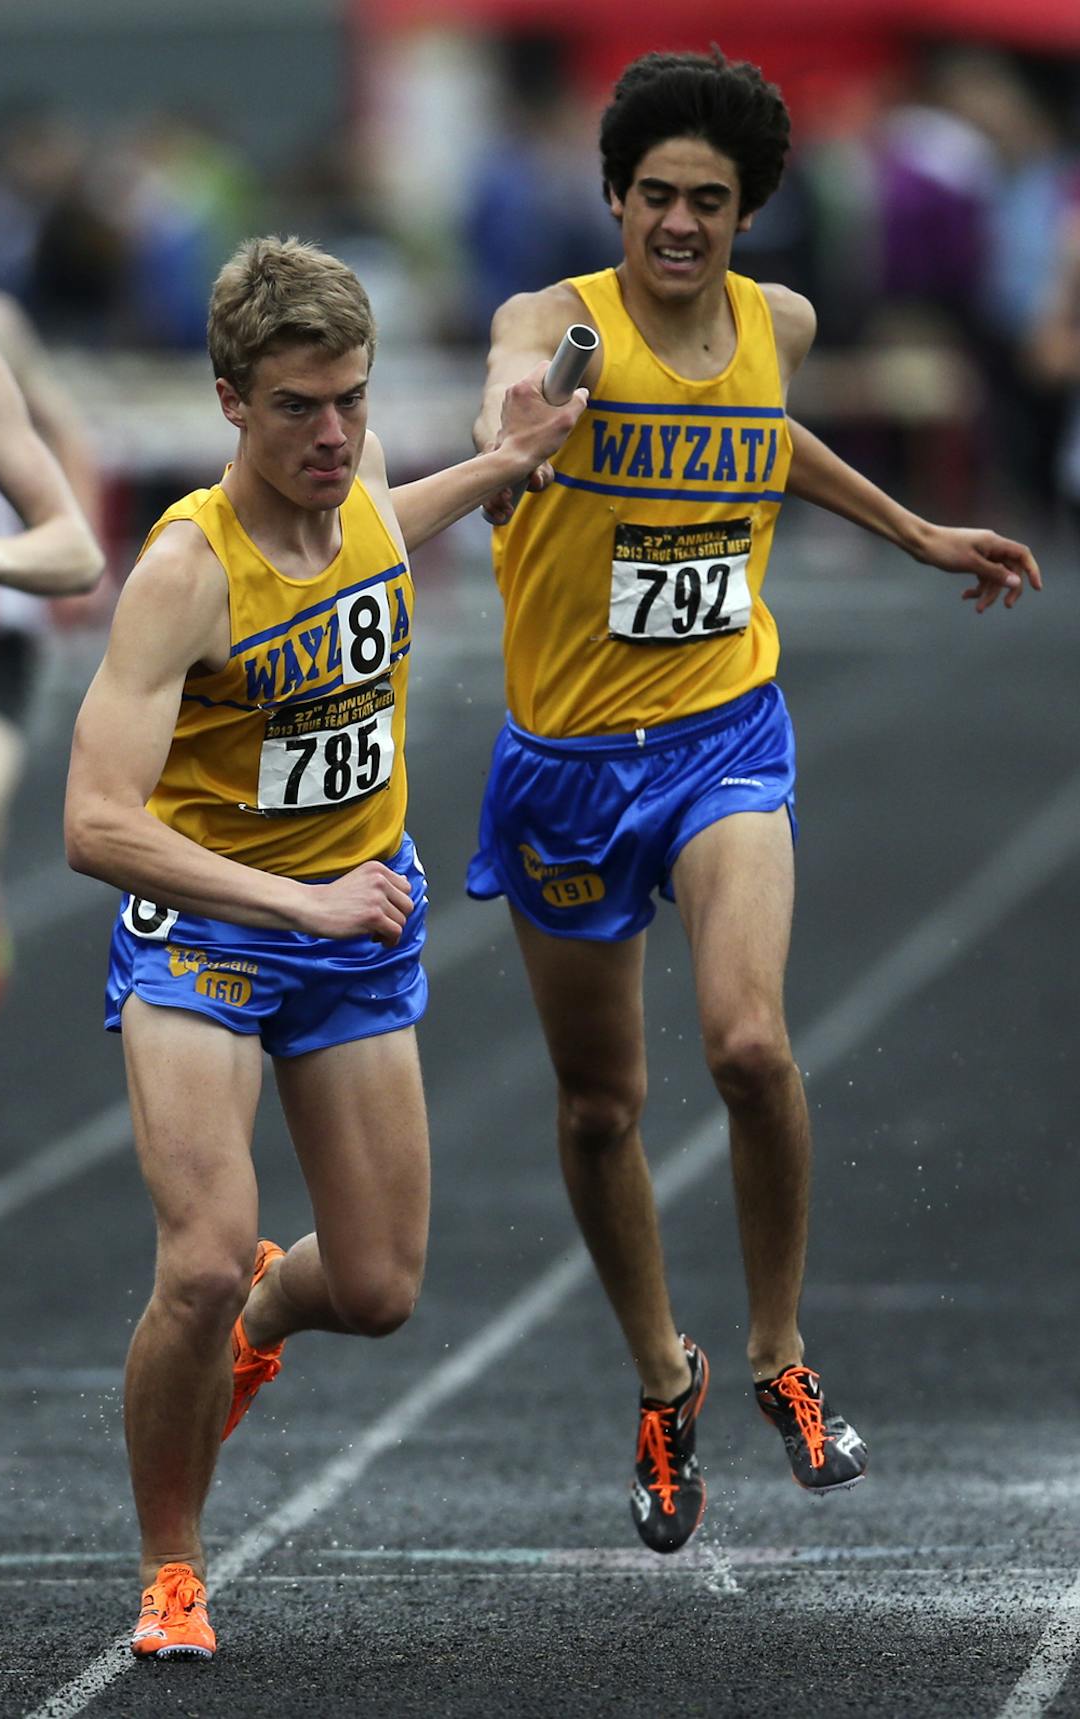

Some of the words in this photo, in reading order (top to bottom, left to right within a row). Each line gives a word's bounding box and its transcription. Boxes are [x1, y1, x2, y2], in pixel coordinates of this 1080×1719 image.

[616, 545, 643, 559] 2013
[647, 548, 671, 561] TRUE
[698, 541, 725, 556] STATE
[727, 538, 751, 553] MEET
[676, 530, 728, 546] ANNUAL
[632, 564, 731, 634] 792
[349, 595, 385, 674] 8
[267, 725, 293, 737] 2013
[297, 720, 322, 733] TRUE
[325, 713, 350, 727] TEAM
[352, 705, 374, 720] STATE
[375, 692, 394, 710] MEET
[327, 689, 378, 714] ANNUAL
[284, 719, 381, 805] 785
[206, 977, 243, 1006] 160
